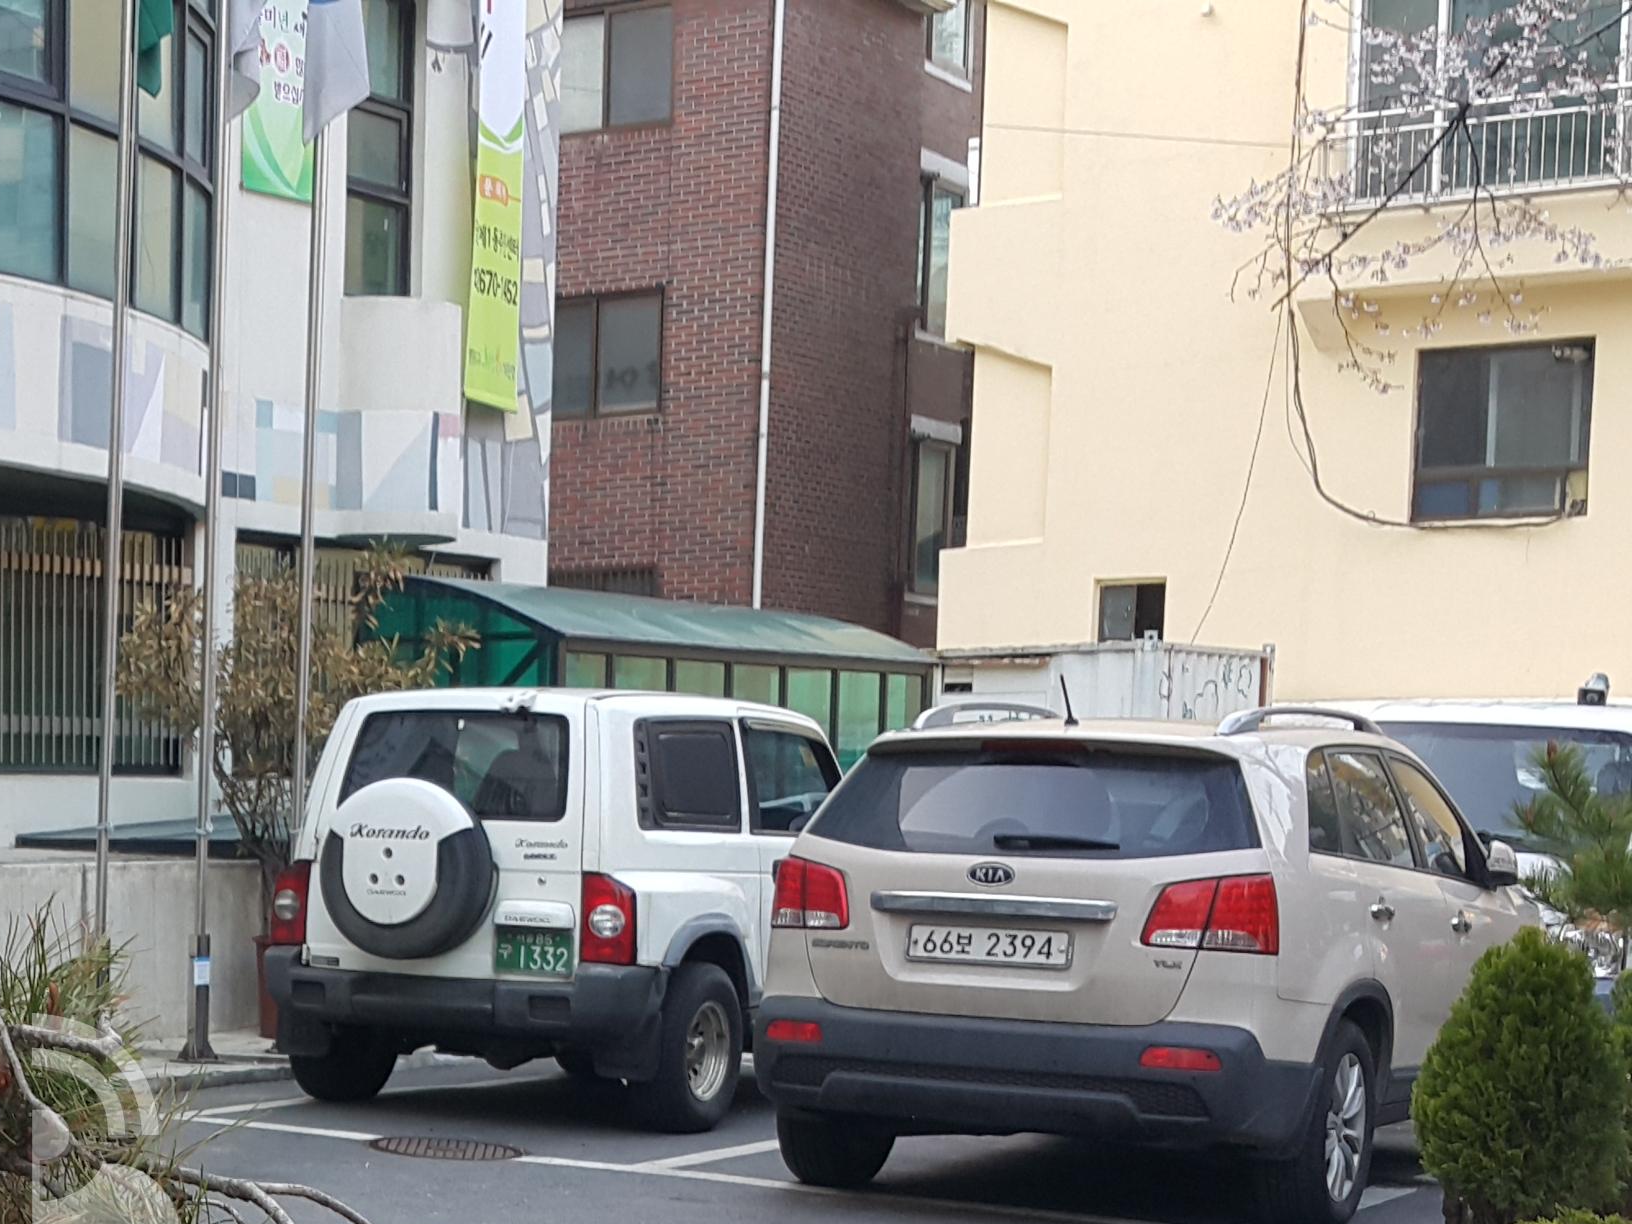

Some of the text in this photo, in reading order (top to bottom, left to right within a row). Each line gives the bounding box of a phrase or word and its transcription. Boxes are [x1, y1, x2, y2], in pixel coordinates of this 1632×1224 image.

[349, 822, 430, 840] Korando
[974, 867, 1007, 883] KIA
[985, 932, 1055, 960] 2394
[519, 945, 569, 972] 1332
